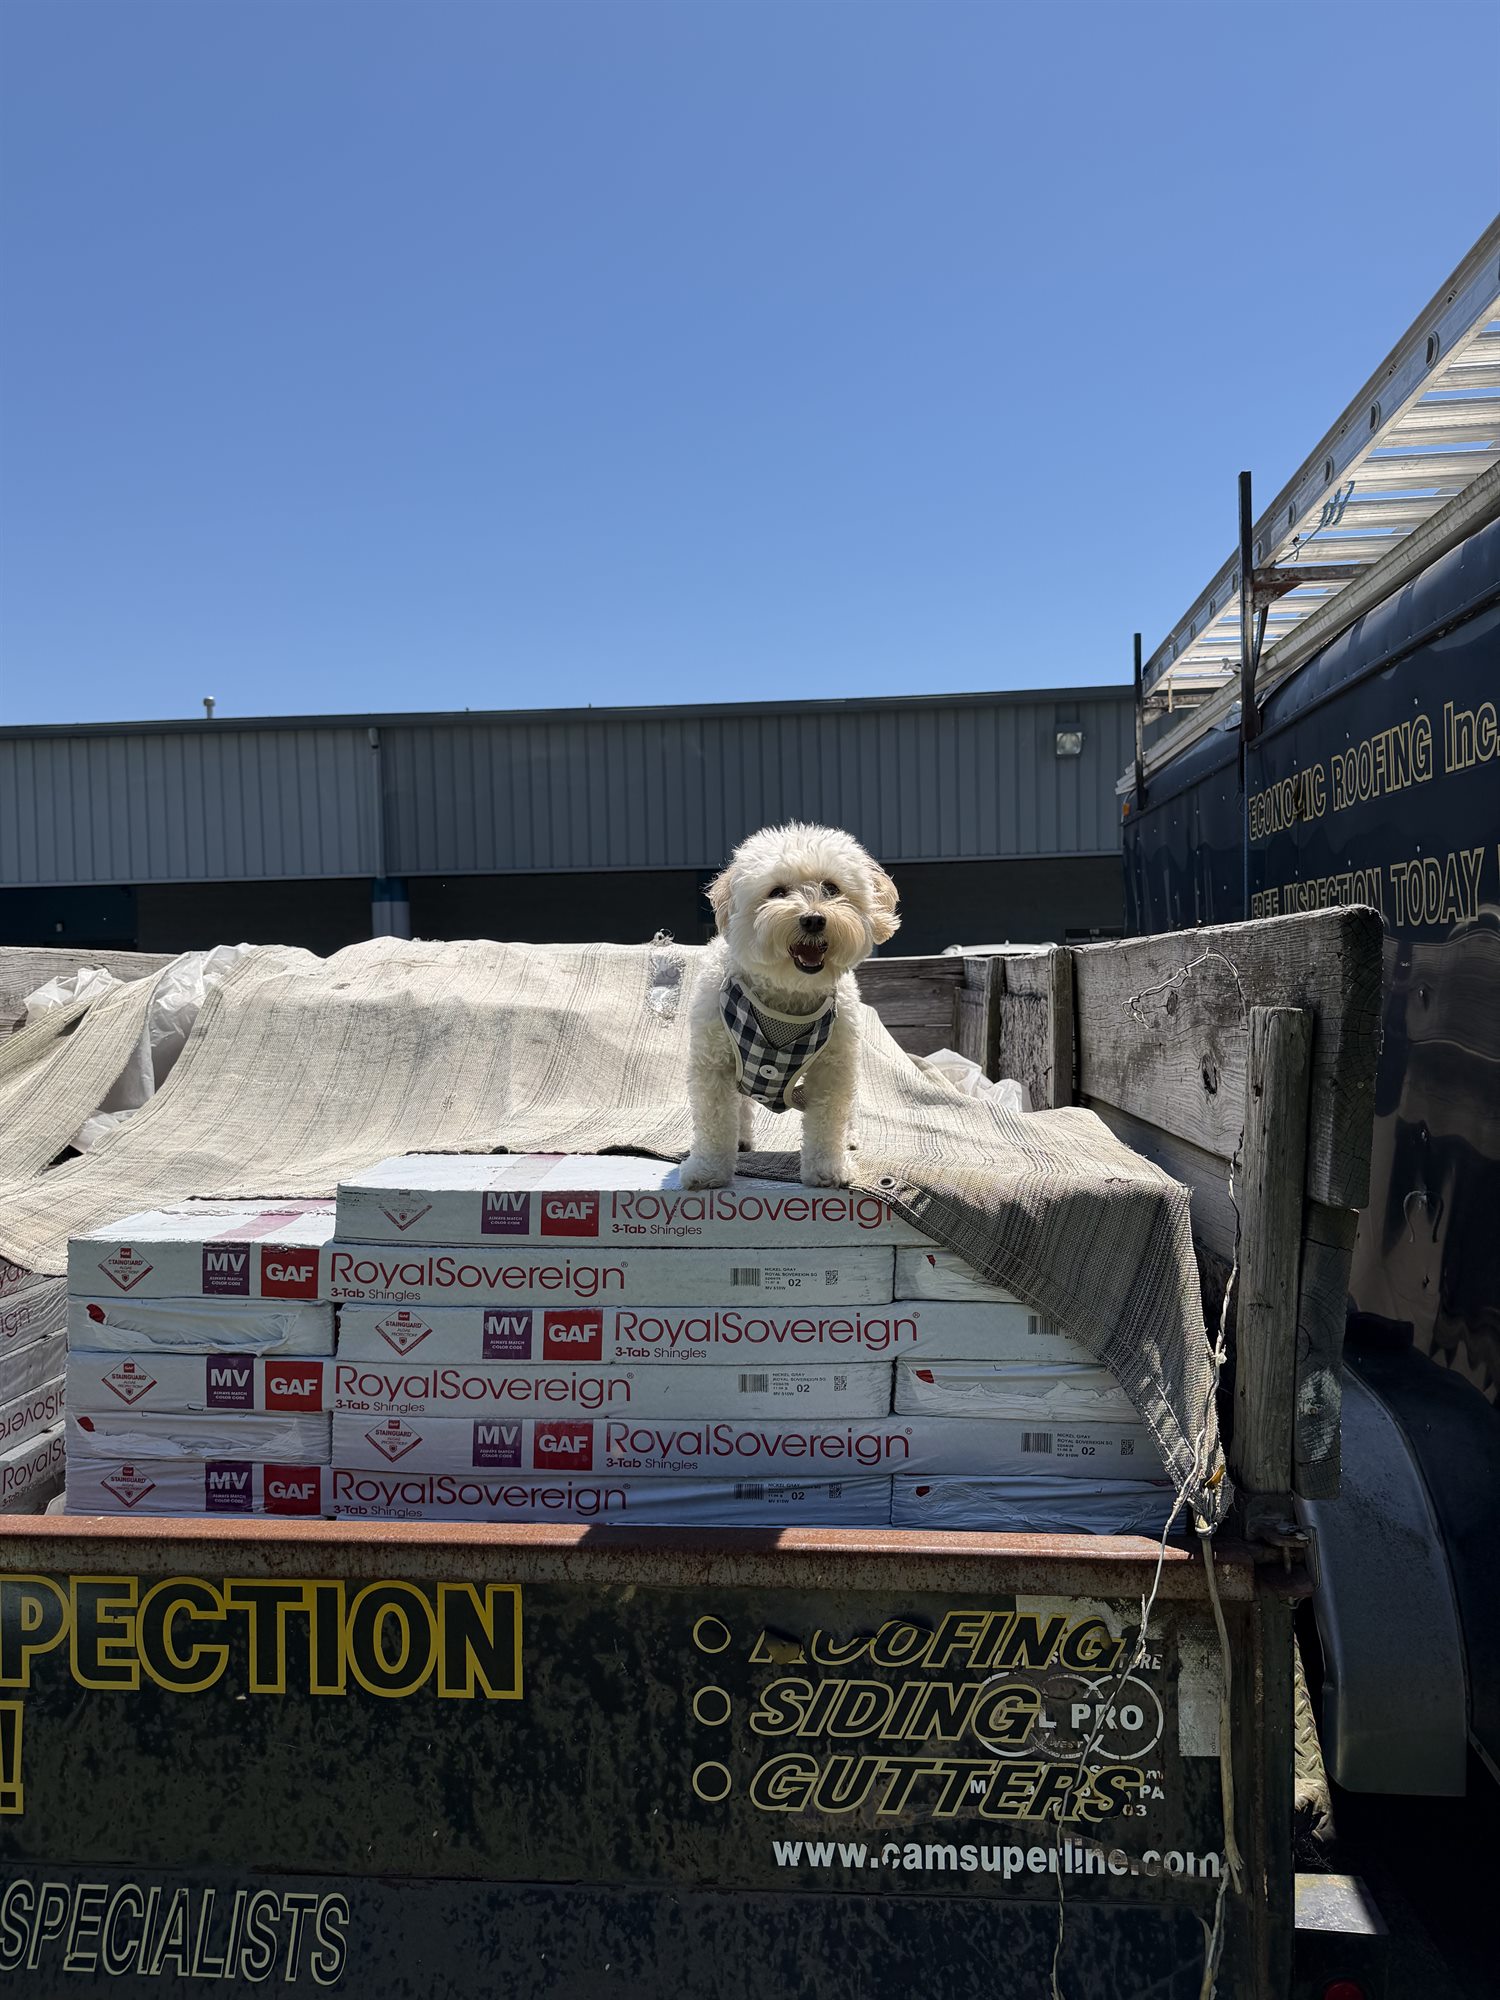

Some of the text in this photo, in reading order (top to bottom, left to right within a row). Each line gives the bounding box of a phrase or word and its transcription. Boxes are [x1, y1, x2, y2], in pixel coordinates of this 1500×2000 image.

[1331, 715, 1432, 811] ROOFING
[1284, 867, 1383, 914] INSPECTION
[1390, 847, 1485, 926] TODAY
[487, 1192, 526, 1212] MV
[546, 1201, 594, 1220] GAF
[612, 1223, 702, 1236] 3-Tab Shingles
[206, 1253, 246, 1272] MV
[265, 1263, 314, 1282] GAF
[788, 1278, 801, 1287] 02
[331, 1287, 421, 1301] 3-Tab Shingles
[385, 1320, 422, 1328] STAINGUARD
[488, 1316, 528, 1335] MV
[548, 1324, 598, 1343] GAF
[615, 1347, 707, 1360] 3-Tab Shingles
[210, 1368, 250, 1387] MV
[270, 1377, 318, 1396] GAF
[796, 1384, 810, 1393] 02
[335, 1400, 425, 1414] 3-Tab Shingles
[375, 1429, 413, 1438] STAINGUARD
[478, 1425, 519, 1445] MV
[538, 1434, 588, 1453] GAF
[1081, 1446, 1096, 1456] 02
[606, 1457, 698, 1471] 3-Tab Shingles
[111, 1476, 147, 1484] STAINGUARD
[209, 1471, 249, 1490] MV
[268, 1481, 316, 1500] GAF
[791, 1491, 805, 1501] 02
[333, 1505, 423, 1518] 3-Tab Shingles
[0, 1575, 524, 1700] PECTION
[749, 1678, 1042, 1743] SIDING
[1071, 1703, 1144, 1731] PRO
[749, 1753, 1145, 1822] GUTTERS
[772, 1838, 1220, 1880] www.camsuperline.com
[0, 1879, 350, 1986] SPECIALISTS
